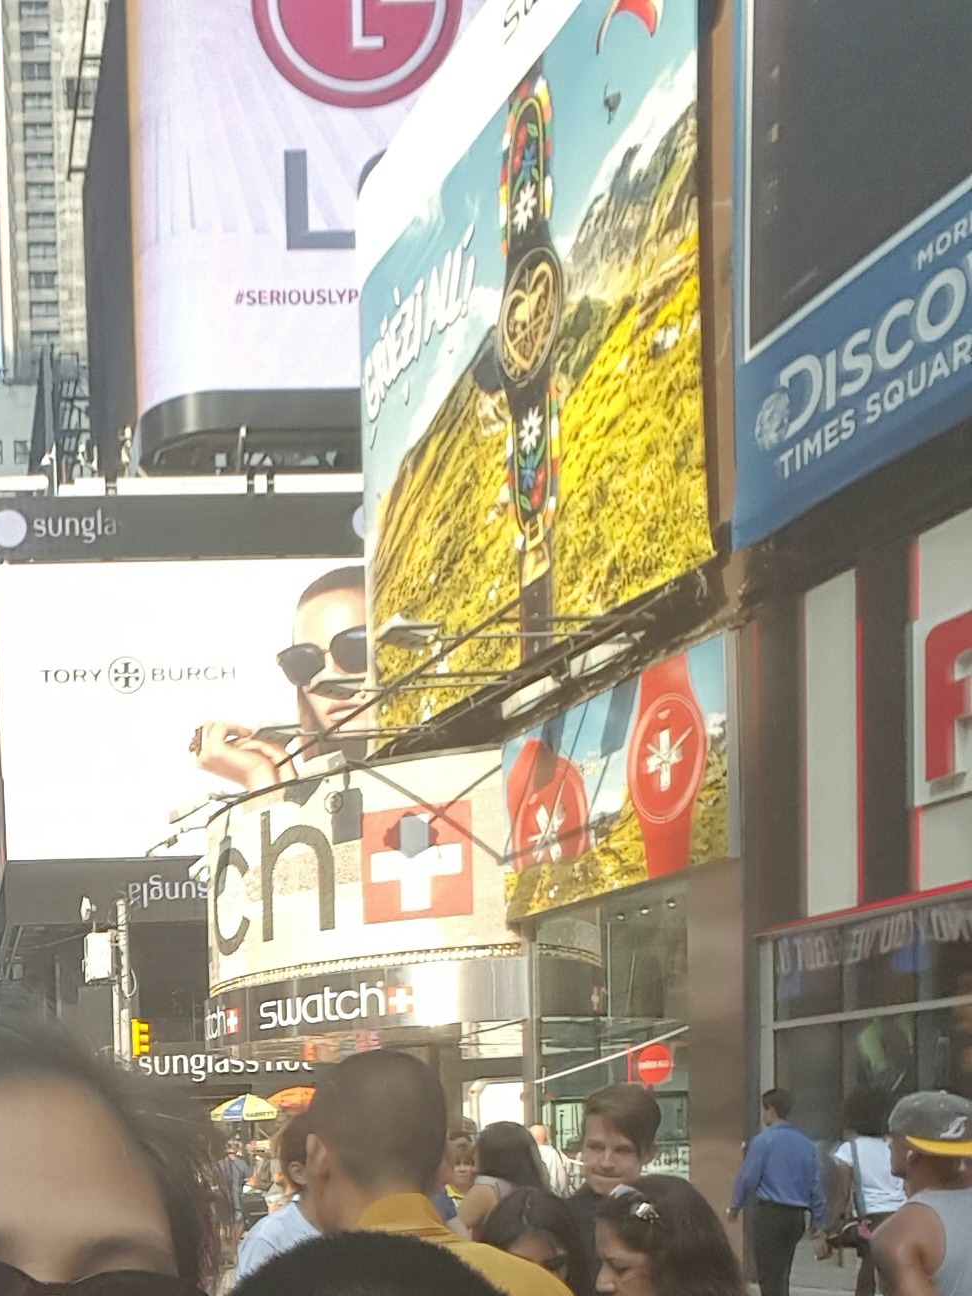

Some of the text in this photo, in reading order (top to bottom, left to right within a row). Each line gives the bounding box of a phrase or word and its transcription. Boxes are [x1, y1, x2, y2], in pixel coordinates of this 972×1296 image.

[284, 148, 387, 250] L
[234, 288, 359, 306] #SERIOUSLYP
[778, 250, 972, 440] DISCO
[779, 408, 856, 479] TIMES
[39, 667, 236, 683] TORY BURCH
[259, 981, 386, 1030] swatch
